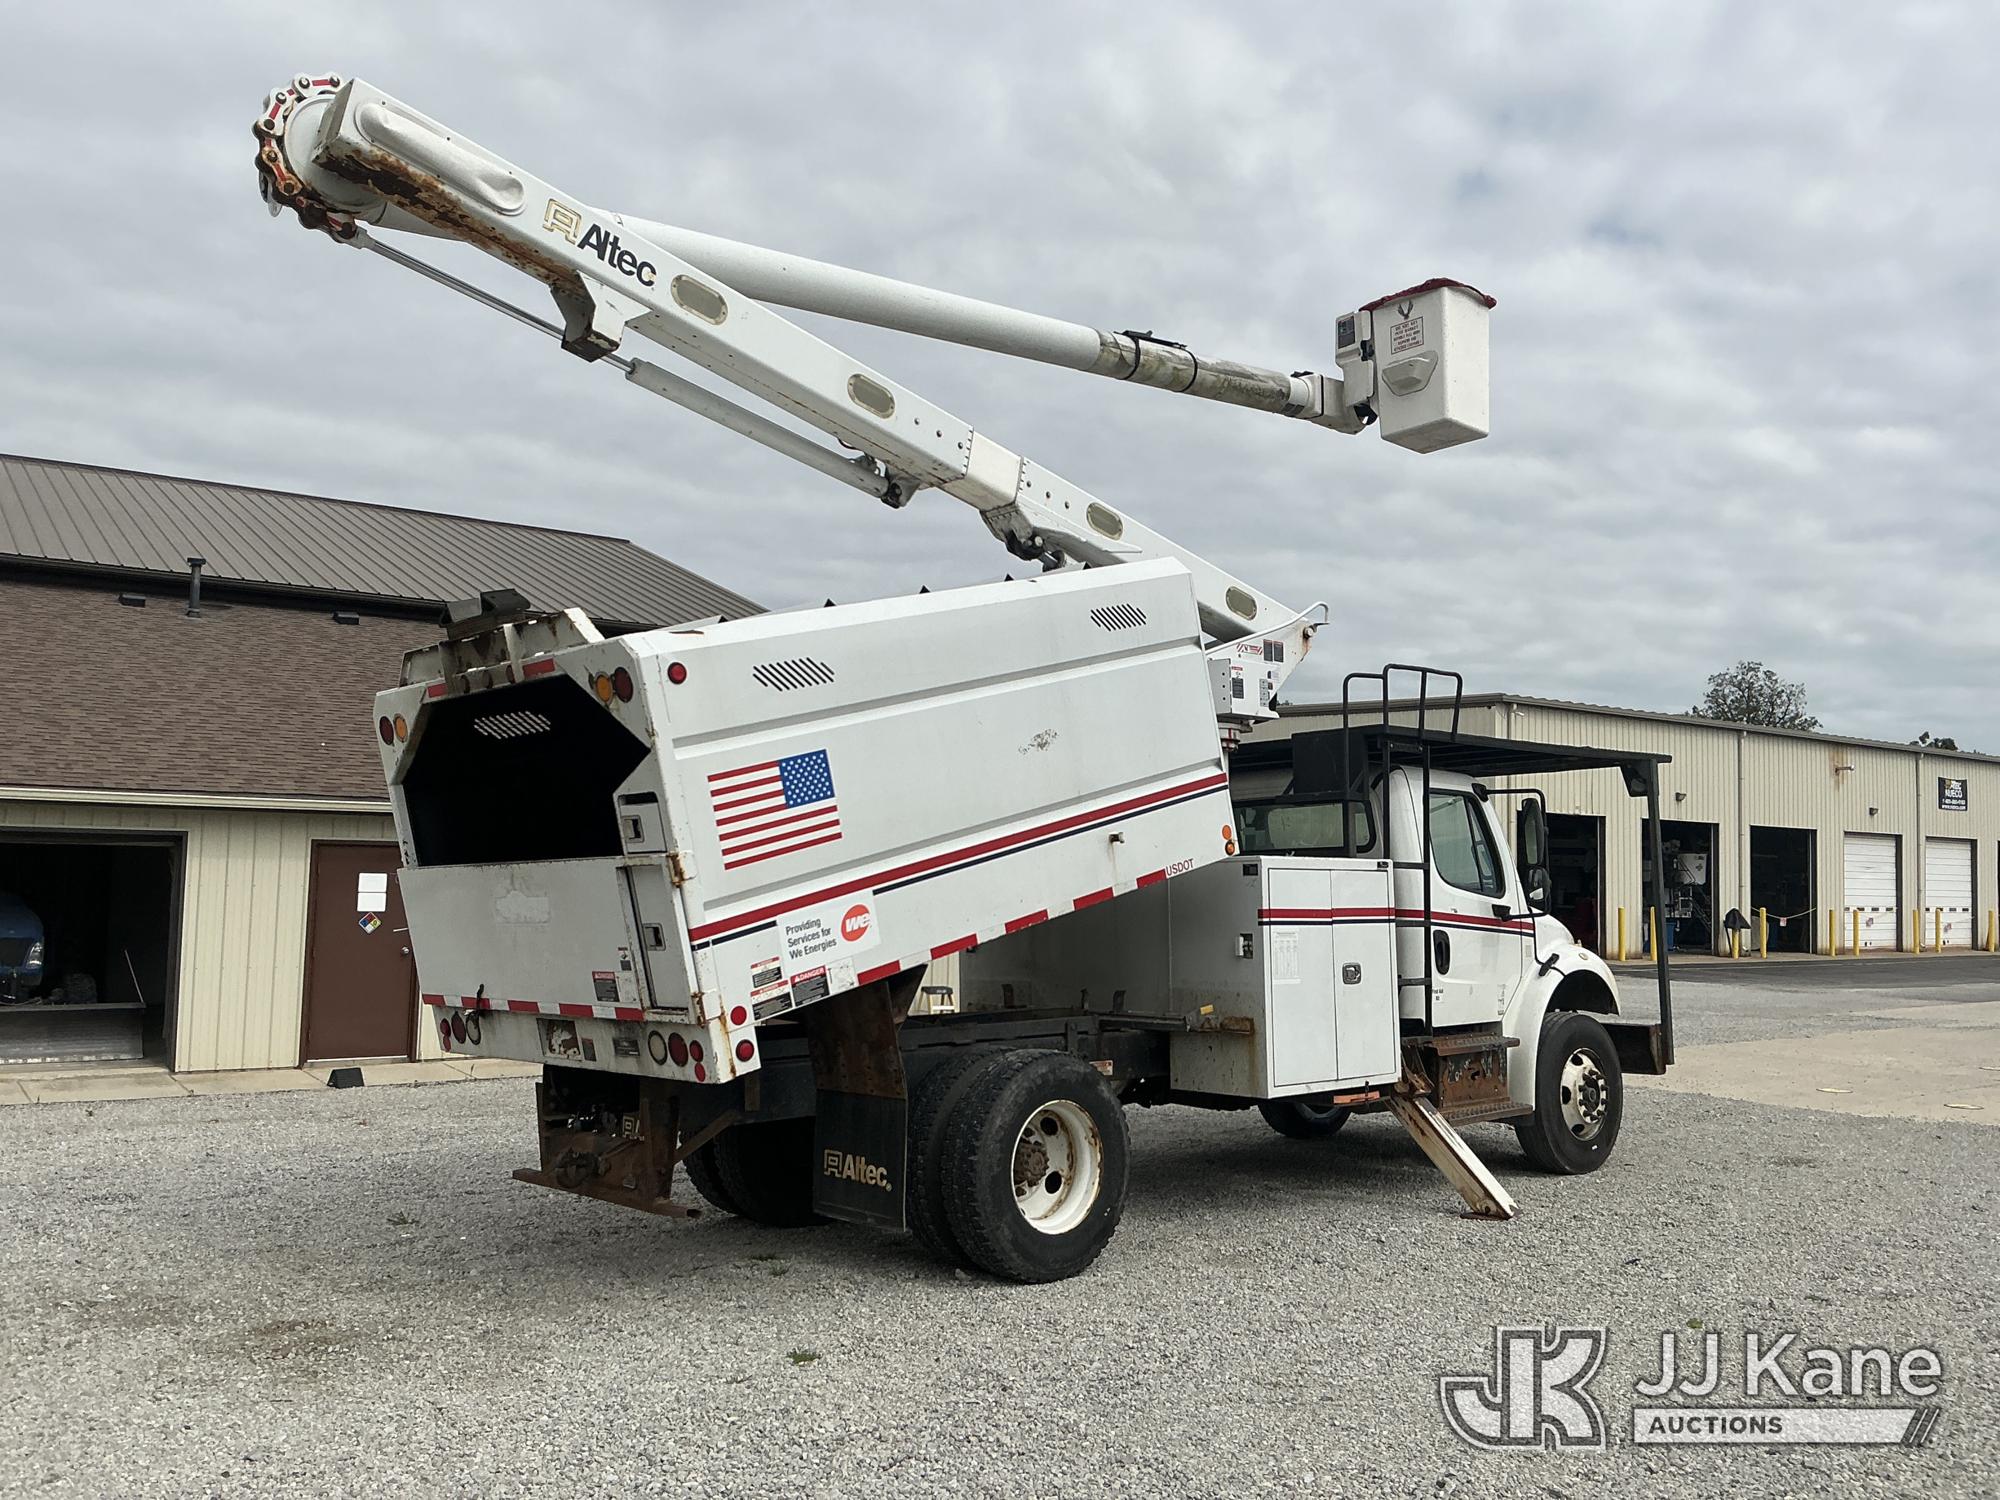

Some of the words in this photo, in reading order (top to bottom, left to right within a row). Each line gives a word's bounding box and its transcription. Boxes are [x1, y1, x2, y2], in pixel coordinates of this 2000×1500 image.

[577, 223, 657, 287] Altec
[1165, 858, 1194, 876] USDOT
[785, 918, 821, 936] Providing
[787, 931, 820, 947] Services
[820, 927, 832, 937] for
[789, 948, 803, 960] We
[803, 938, 837, 955] Energies
[800, 967, 825, 980] DANGER
[842, 1154, 887, 1187] Altec
